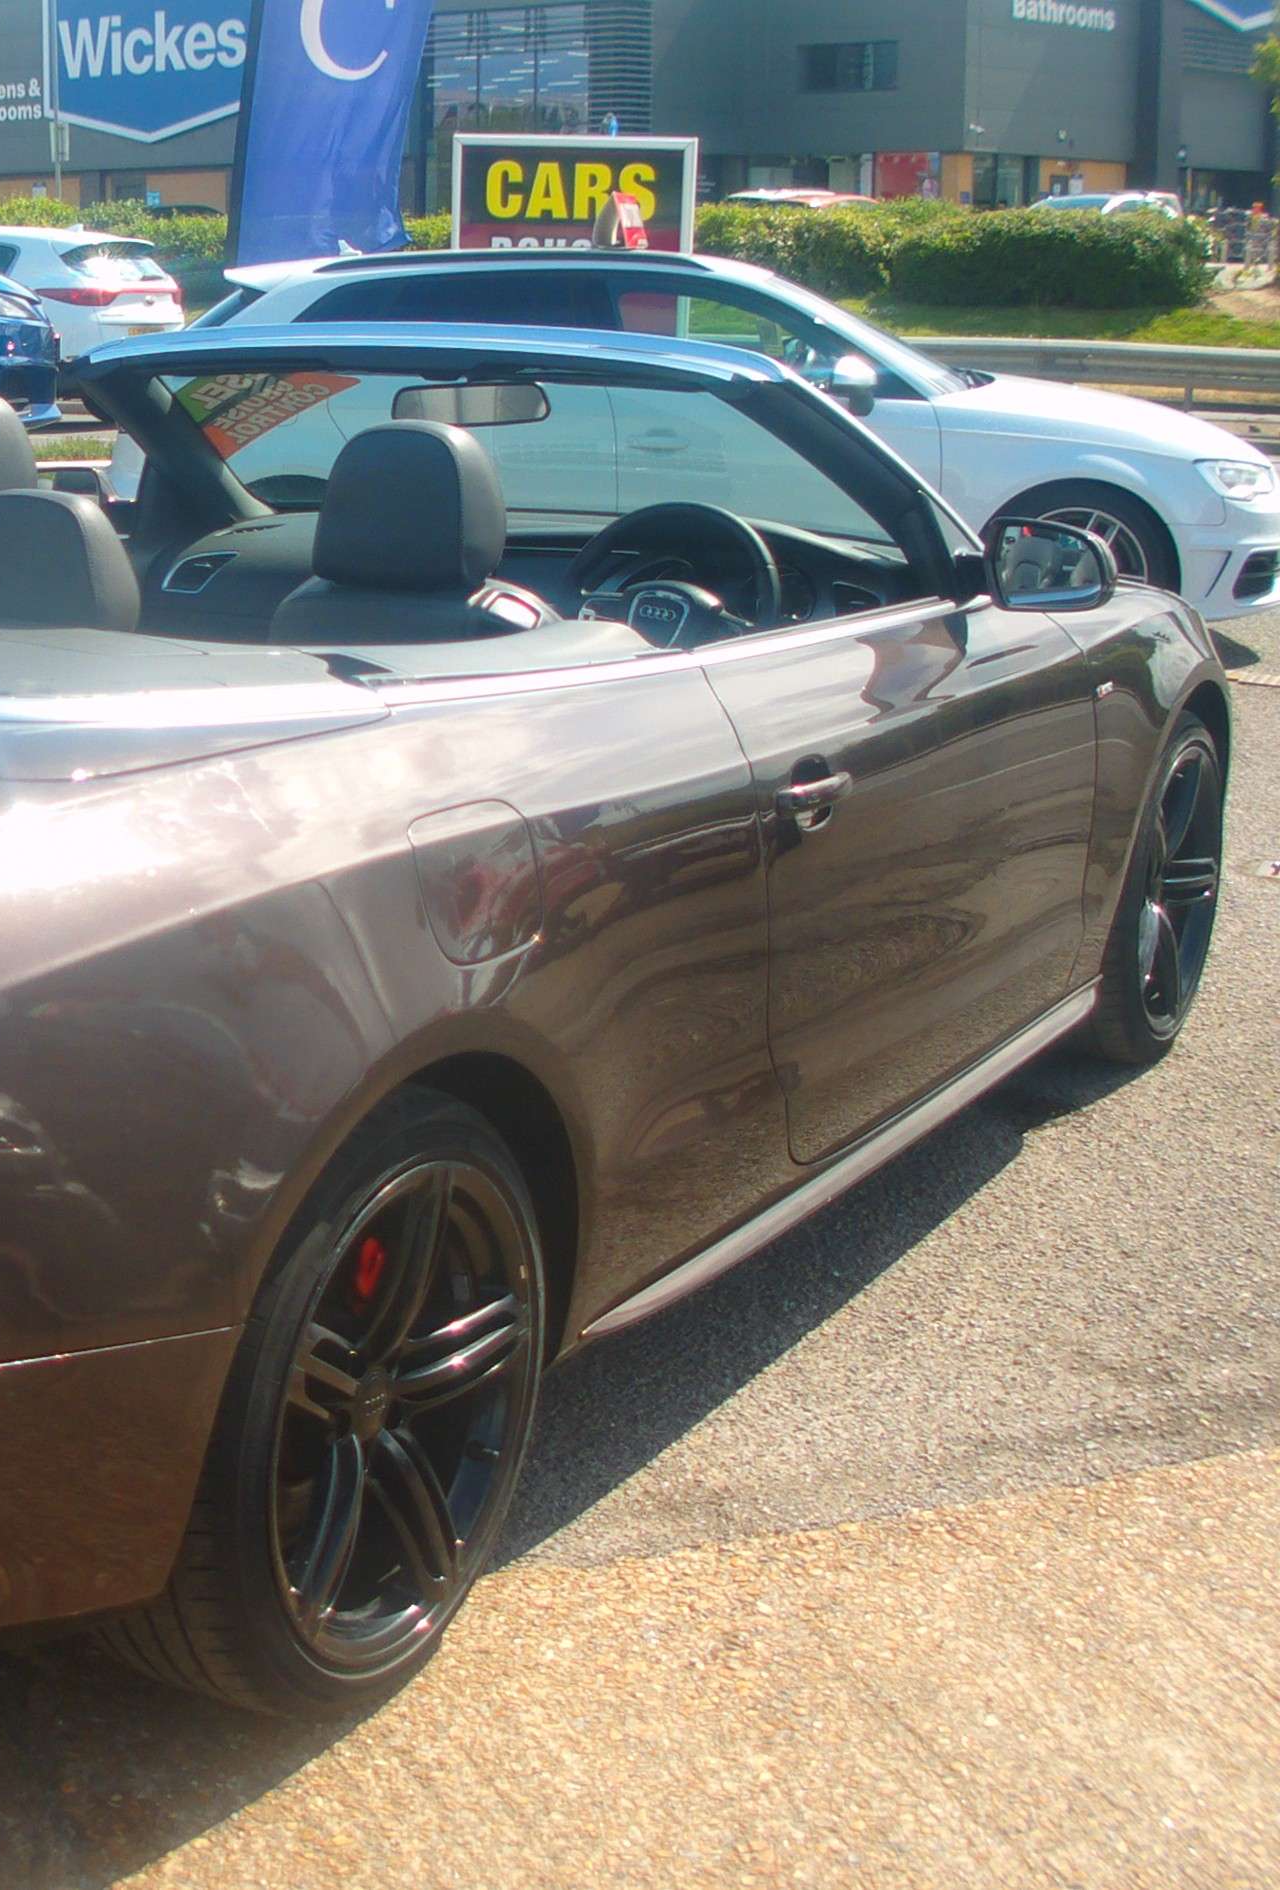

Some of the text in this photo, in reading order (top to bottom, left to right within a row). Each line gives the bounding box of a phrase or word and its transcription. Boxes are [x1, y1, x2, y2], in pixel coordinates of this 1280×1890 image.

[1012, 0, 1116, 32] Bathrooms
[58, 10, 247, 80] Wickes
[28, 77, 41, 98] &
[486, 159, 656, 222] CARS
